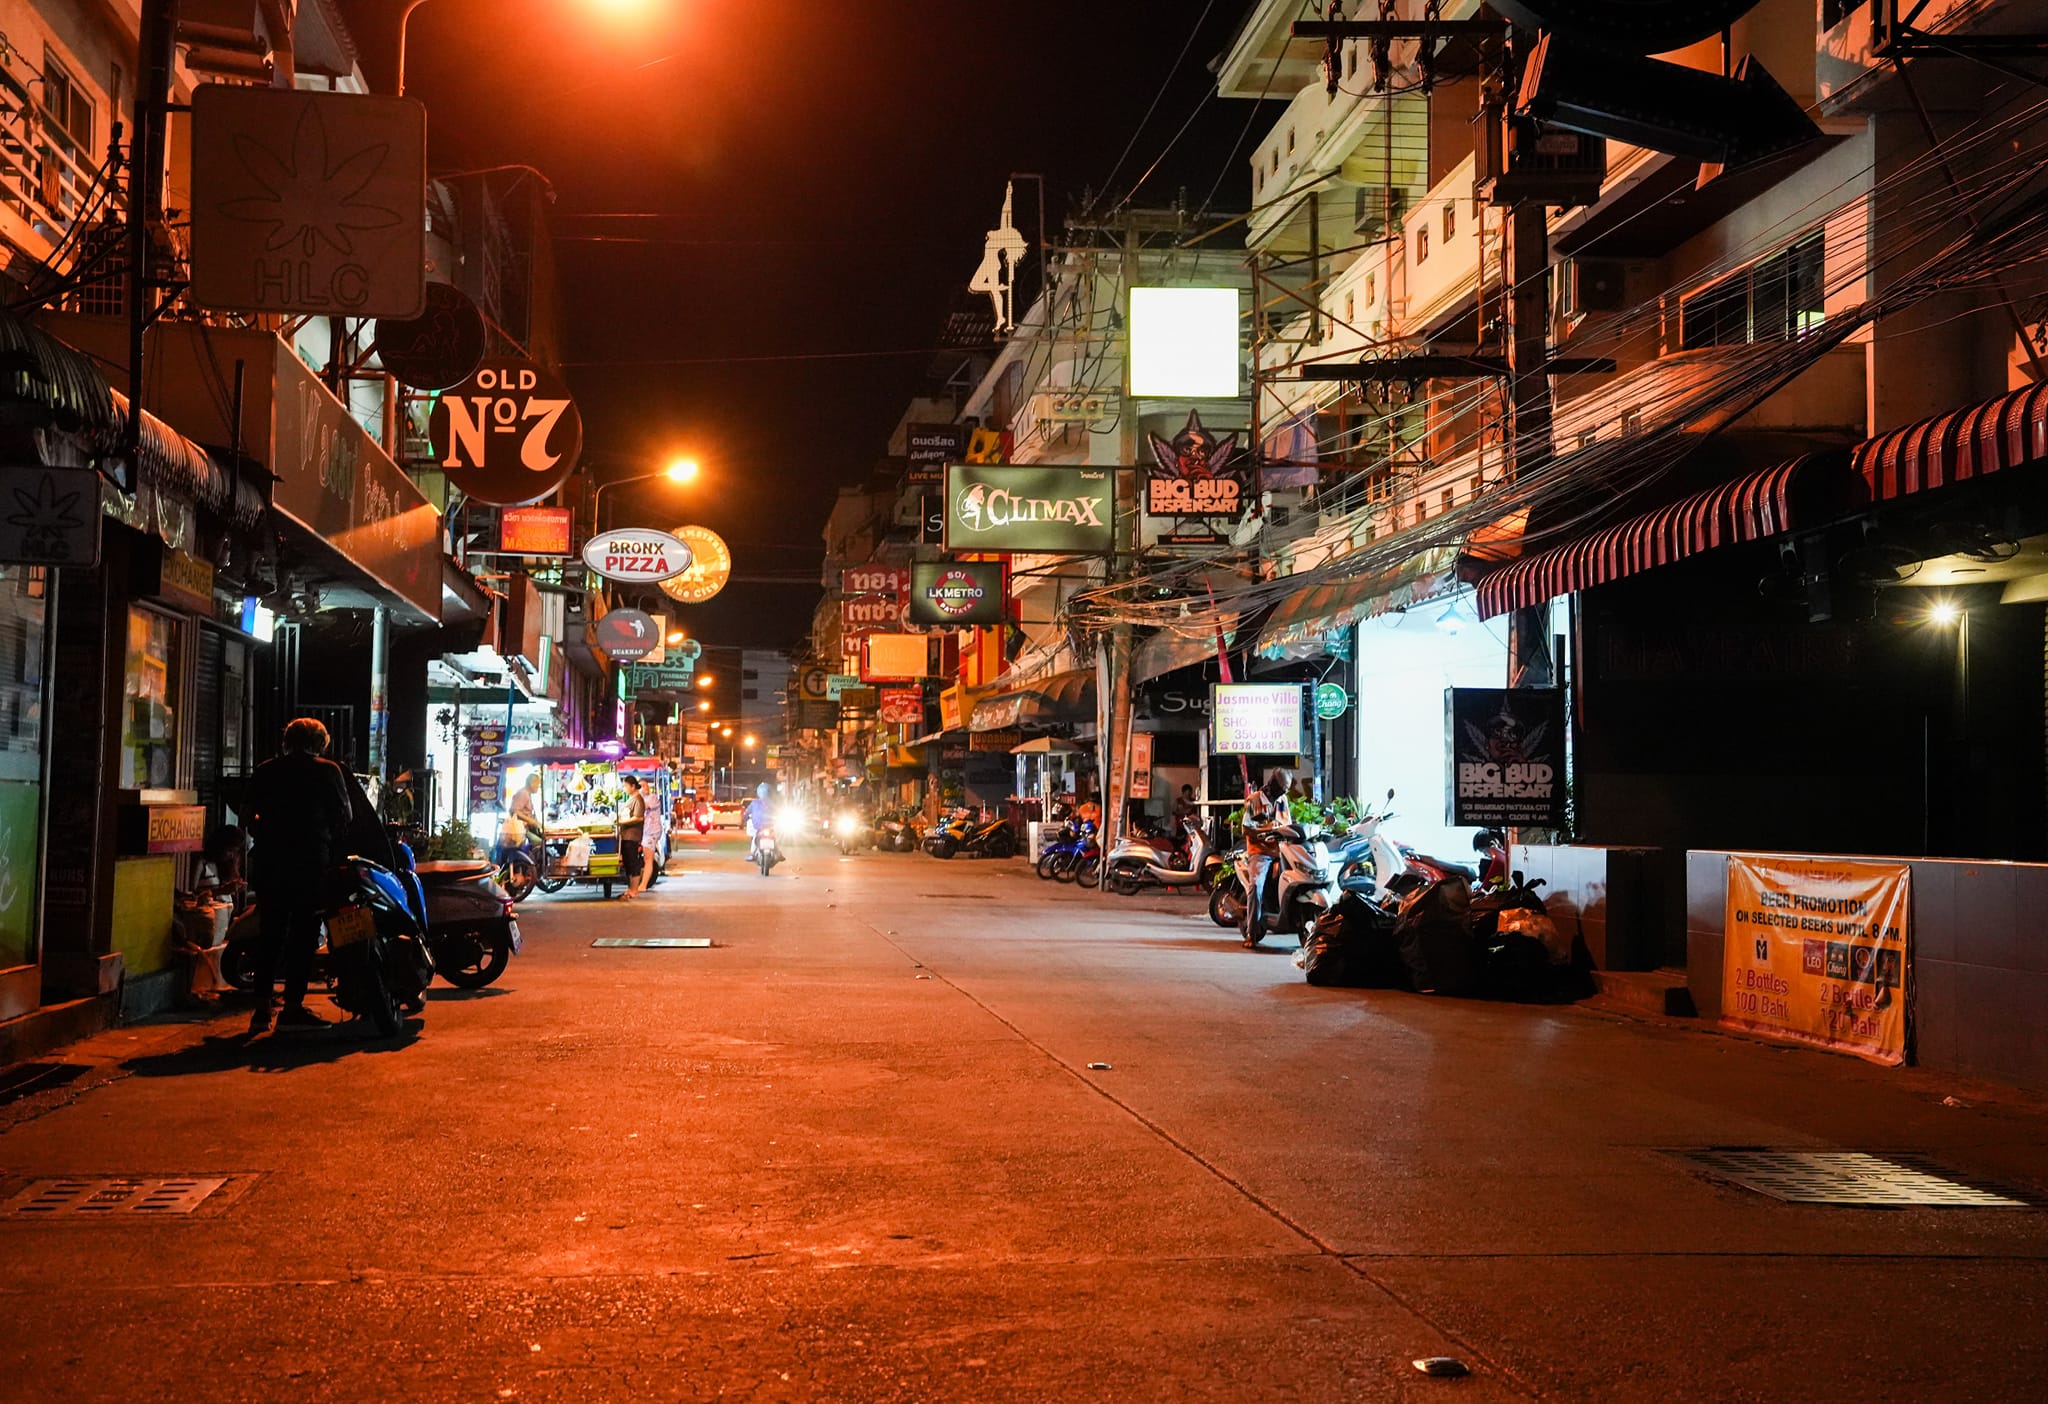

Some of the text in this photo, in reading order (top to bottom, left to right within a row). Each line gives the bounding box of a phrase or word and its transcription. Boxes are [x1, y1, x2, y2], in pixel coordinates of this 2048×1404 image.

[255, 259, 370, 308] HLC
[477, 369, 536, 390] OLD
[909, 472, 928, 480] LIVE
[1150, 479, 1239, 502] BIG BUD
[1150, 498, 1239, 513] DISPENSARY
[505, 537, 565, 550] MASSAGE
[610, 541, 664, 555] BRONX
[605, 556, 670, 573] PIZZA
[947, 571, 966, 580] SOI
[940, 602, 972, 614] PATTAYA
[1160, 692, 1210, 715] Sug
[1272, 692, 1298, 704] Villa
[1318, 700, 1341, 708] Chang
[1232, 741, 1297, 750] 038 488 534
[1459, 762, 1553, 784] BIG BUD
[1459, 783, 1553, 798] DISPENSARY
[151, 818, 201, 840] EXCHANGE
[1761, 892, 1868, 916] BEER PROMOTION
[1736, 910, 1749, 922] ON
[1752, 912, 1798, 929] SELECTED
[1801, 917, 1833, 933] BEERS
[1837, 922, 1869, 937] UNTIL
[1872, 924, 1879, 938] 8
[1807, 958, 1847, 976] LEO Chang
[1736, 968, 1789, 994] 2 Bottles
[1821, 983, 1828, 1002] 2
[1736, 992, 1789, 1018] 100 Baht
[1852, 1016, 1881, 1038] Baht
